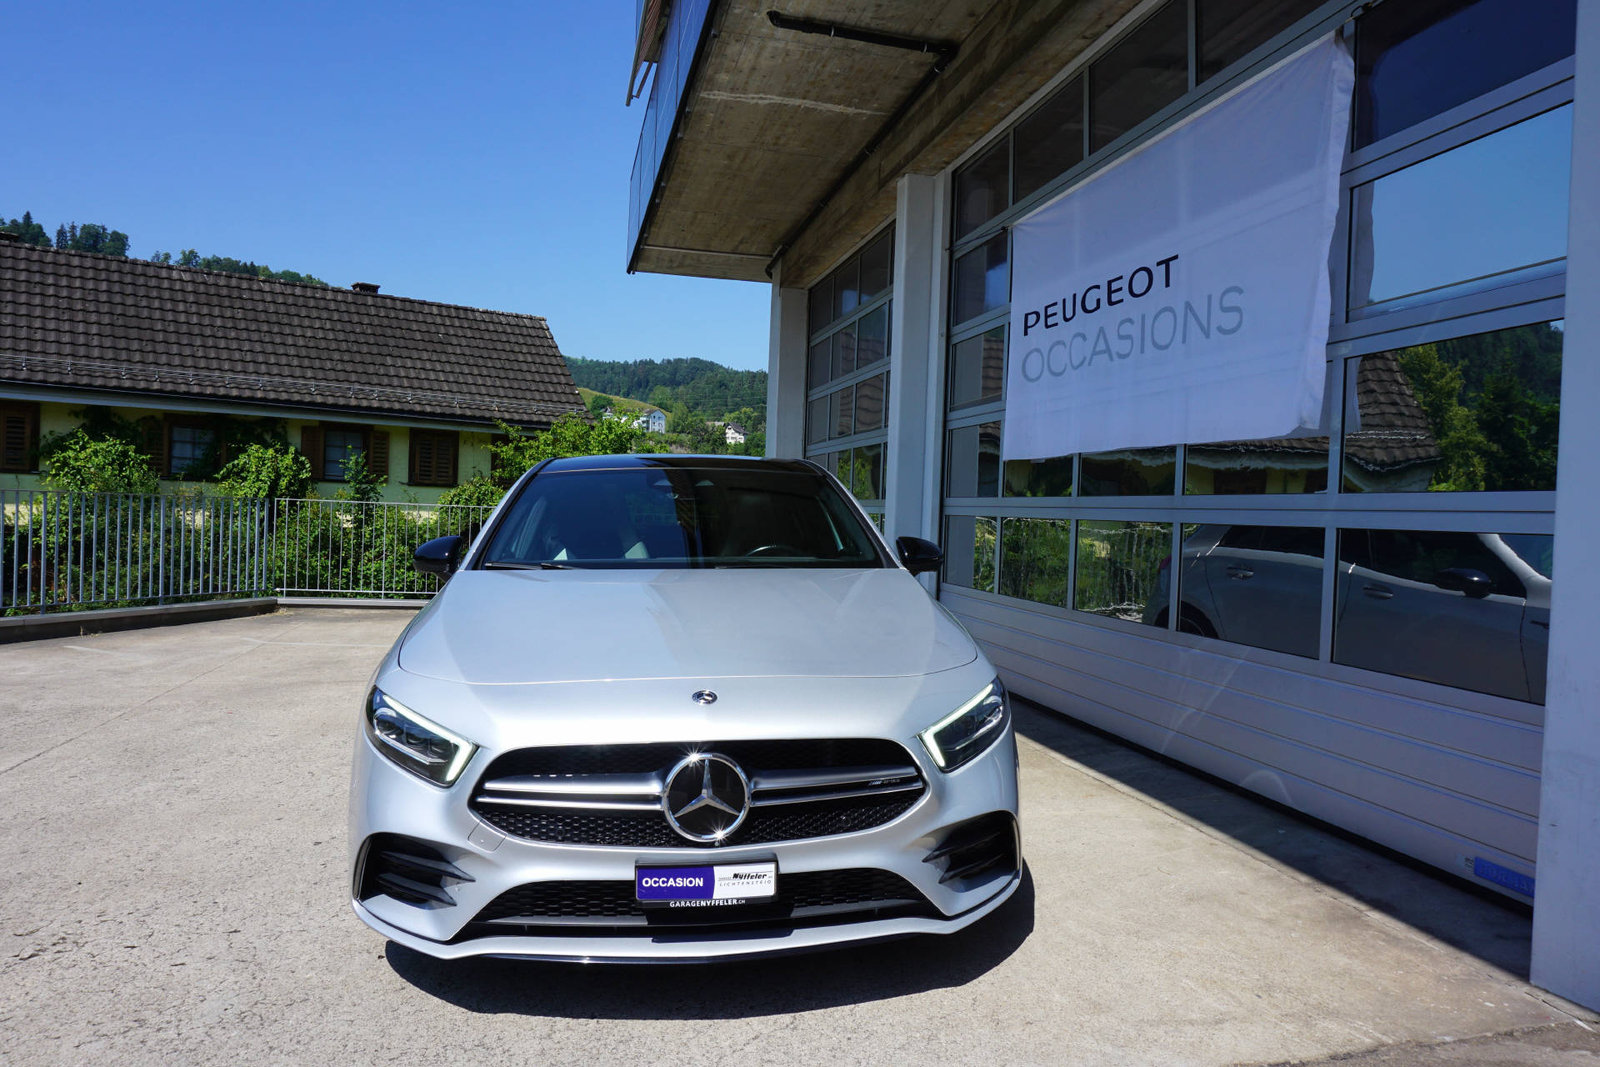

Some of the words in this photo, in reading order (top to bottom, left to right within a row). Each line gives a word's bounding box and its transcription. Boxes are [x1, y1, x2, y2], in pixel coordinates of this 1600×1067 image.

[1023, 254, 1179, 336] PEUGEOT
[1021, 285, 1245, 383] OCCASIONS
[641, 877, 704, 888] OCCASION
[669, 898, 746, 908] GARAGENYFFELER.CH
